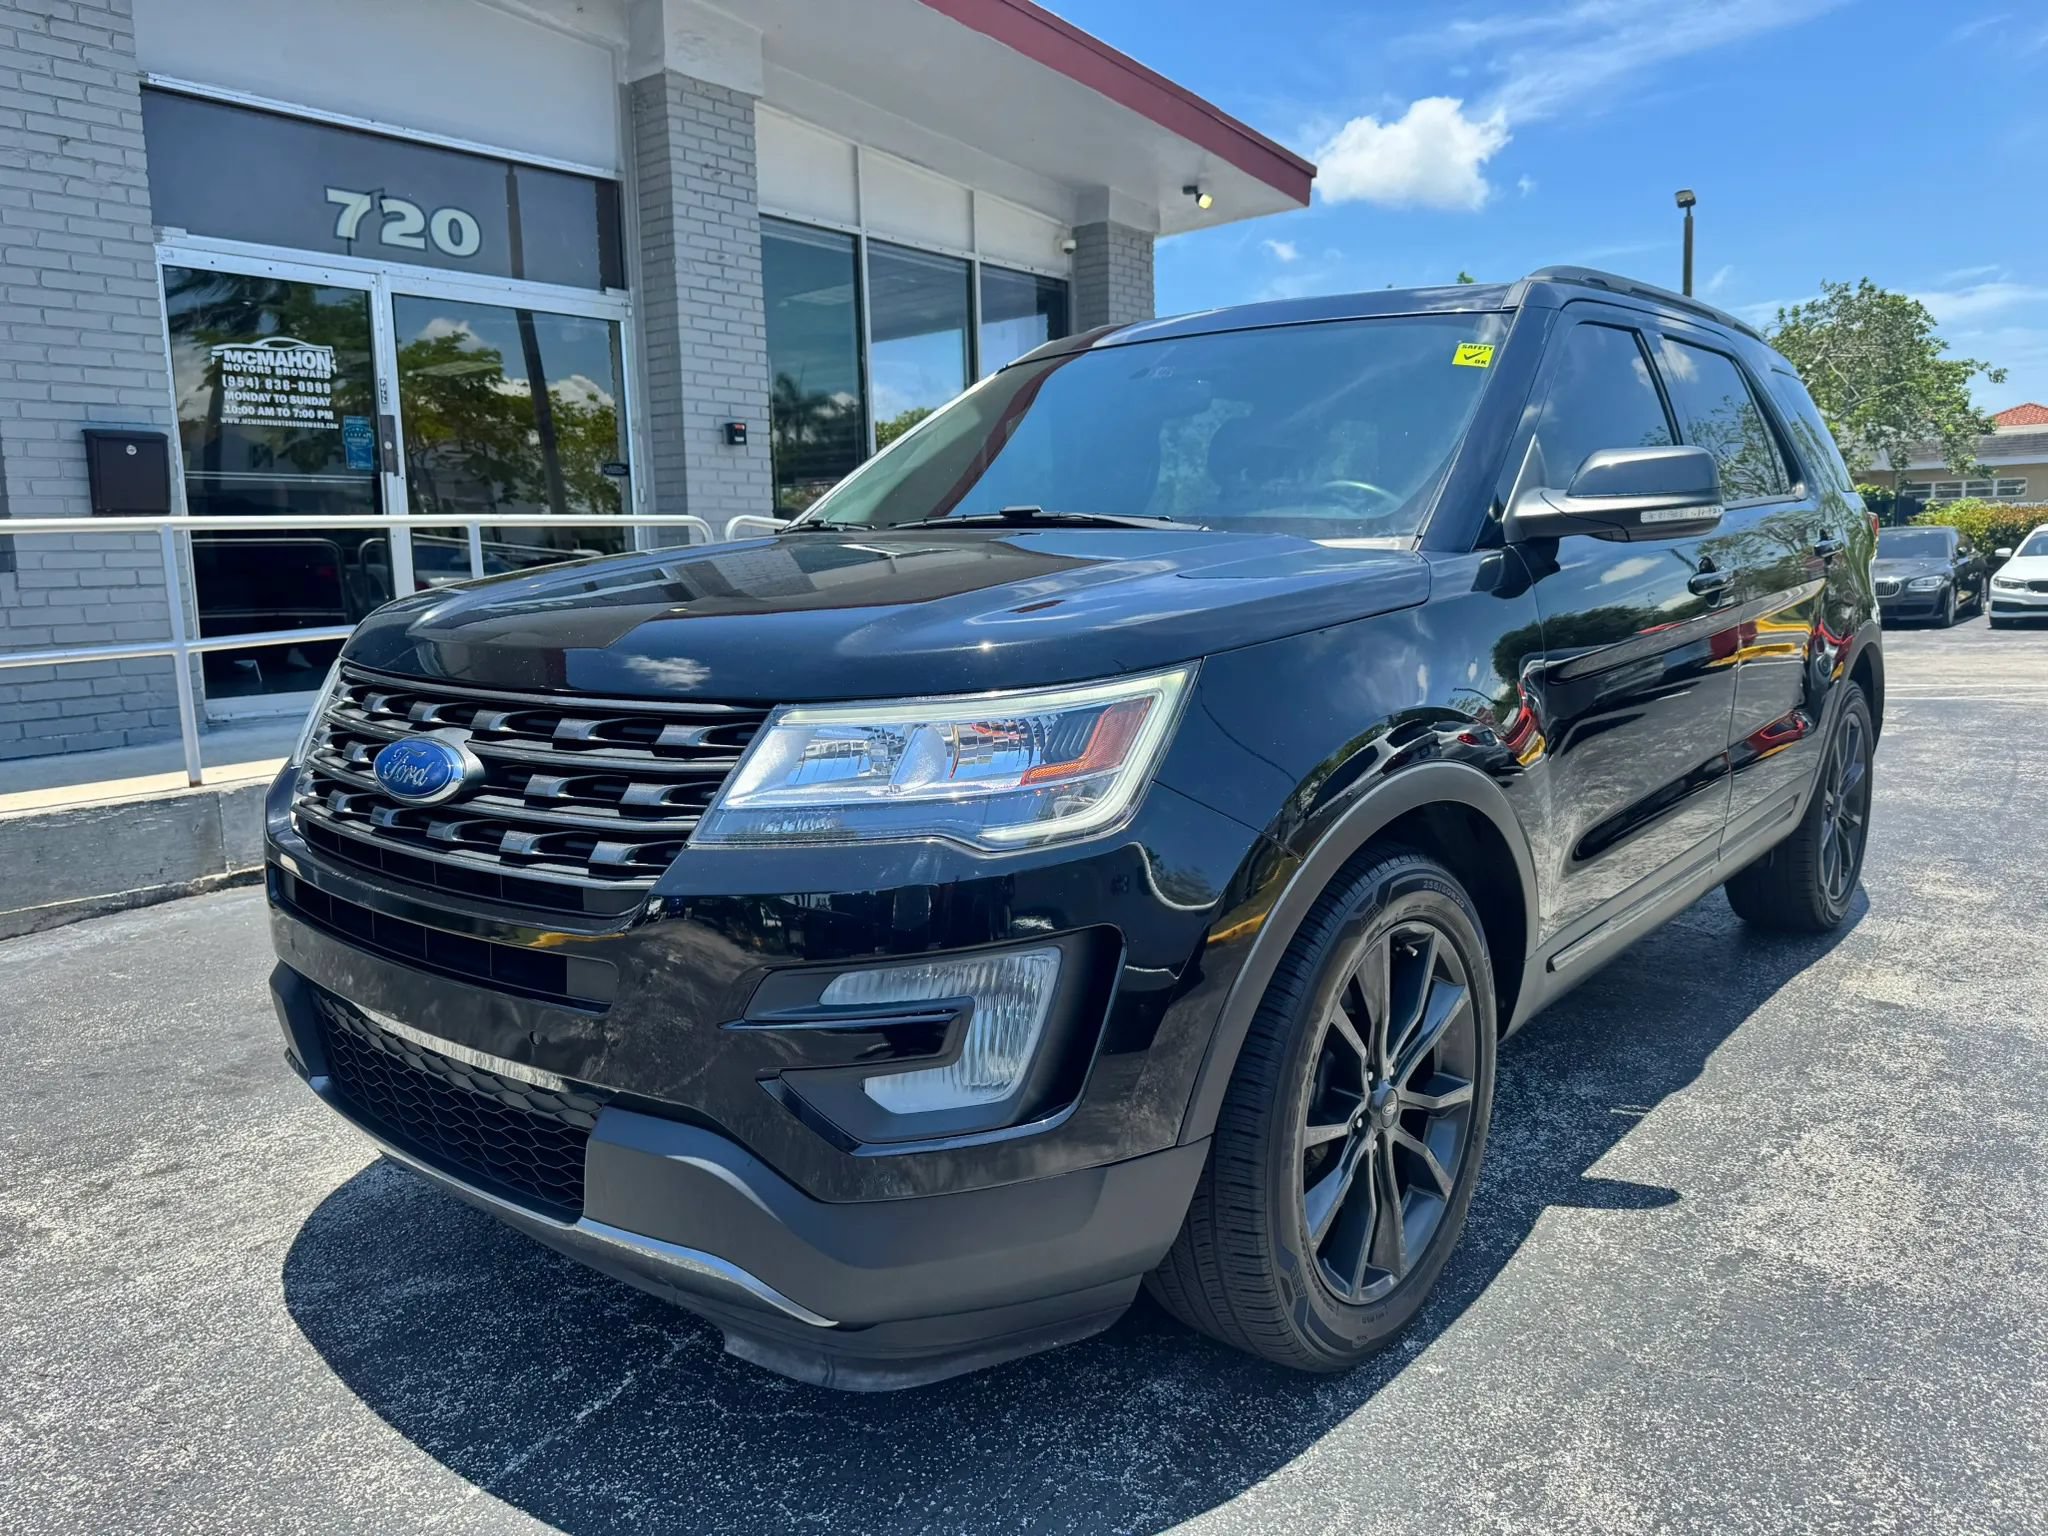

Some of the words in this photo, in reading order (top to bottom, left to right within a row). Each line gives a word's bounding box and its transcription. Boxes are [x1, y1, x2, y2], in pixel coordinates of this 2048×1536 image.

[325, 186, 481, 257] 720
[224, 350, 331, 371] MCMAHON
[223, 363, 271, 374] MOTORS
[275, 366, 331, 379] BROWARD
[222, 374, 259, 390] (954)
[224, 391, 271, 403] MONDAY
[273, 393, 287, 403] TO
[289, 395, 331, 406] SUNDAY
[224, 404, 255, 415] 10:00
[257, 406, 274, 416] AM
[276, 407, 290, 417] TO
[293, 408, 315, 418] 7:00
[316, 410, 334, 420] PM
[380, 747, 436, 786] Ford
